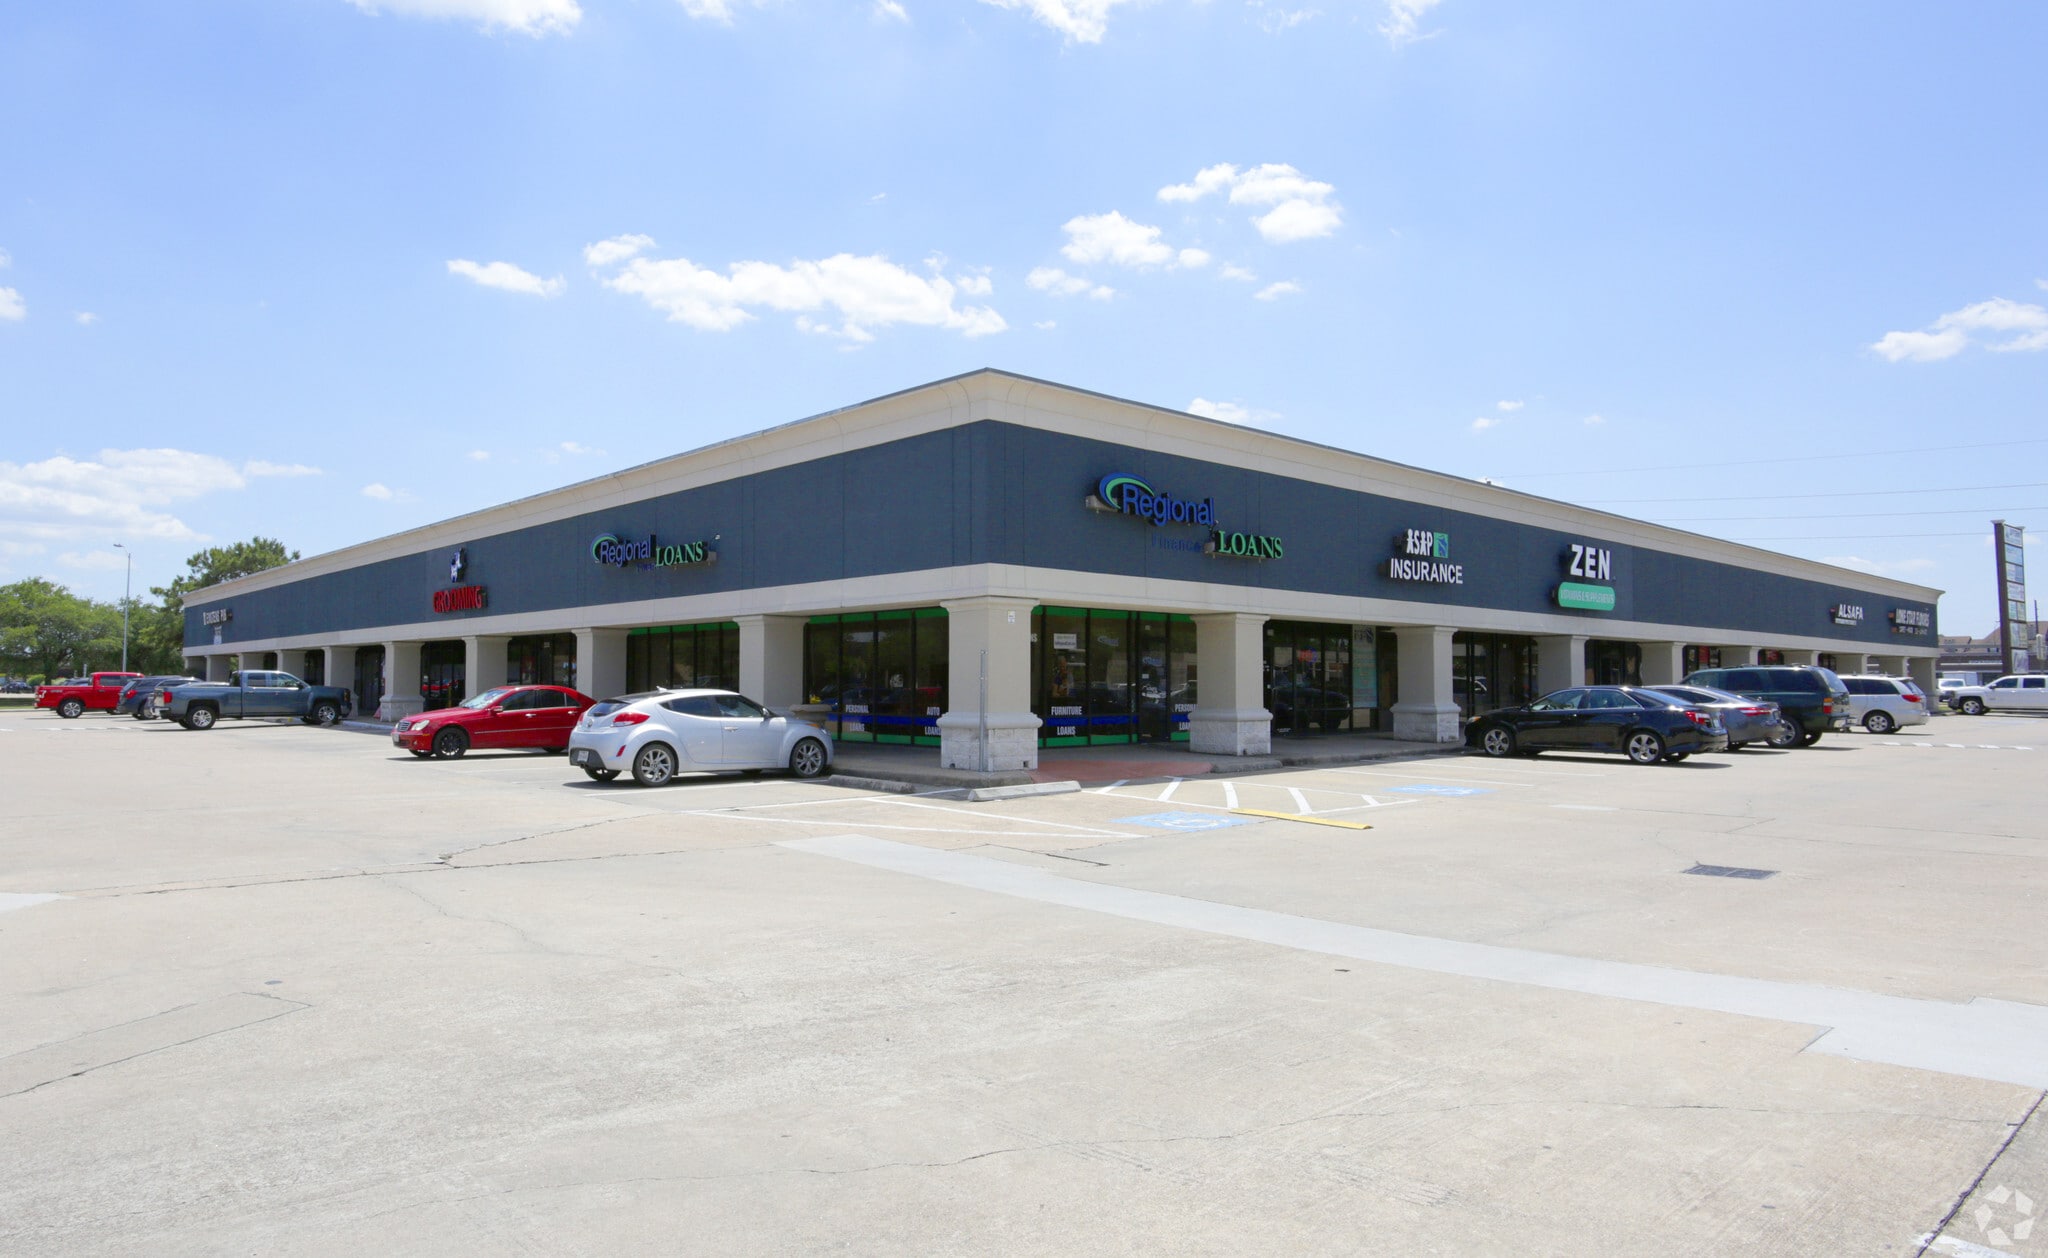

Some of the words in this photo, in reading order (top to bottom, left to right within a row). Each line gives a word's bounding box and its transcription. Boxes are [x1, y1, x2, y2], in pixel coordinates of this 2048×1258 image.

[1122, 484, 1214, 527] Regional
[600, 533, 651, 568] Regional
[656, 541, 705, 568] LOANS
[1218, 530, 1284, 559] LOANS
[1406, 528, 1433, 556] ASAP
[1390, 558, 1463, 584] INSURANCE
[1570, 544, 1611, 580] ZEN
[433, 585, 482, 613] GROOMING
[1838, 603, 1864, 620] ALSAFA
[845, 704, 869, 714] PERSONAL
[927, 706, 940, 716] AUTO
[1051, 706, 1082, 716] FURNITURE
[1057, 726, 1076, 736] LOANS
